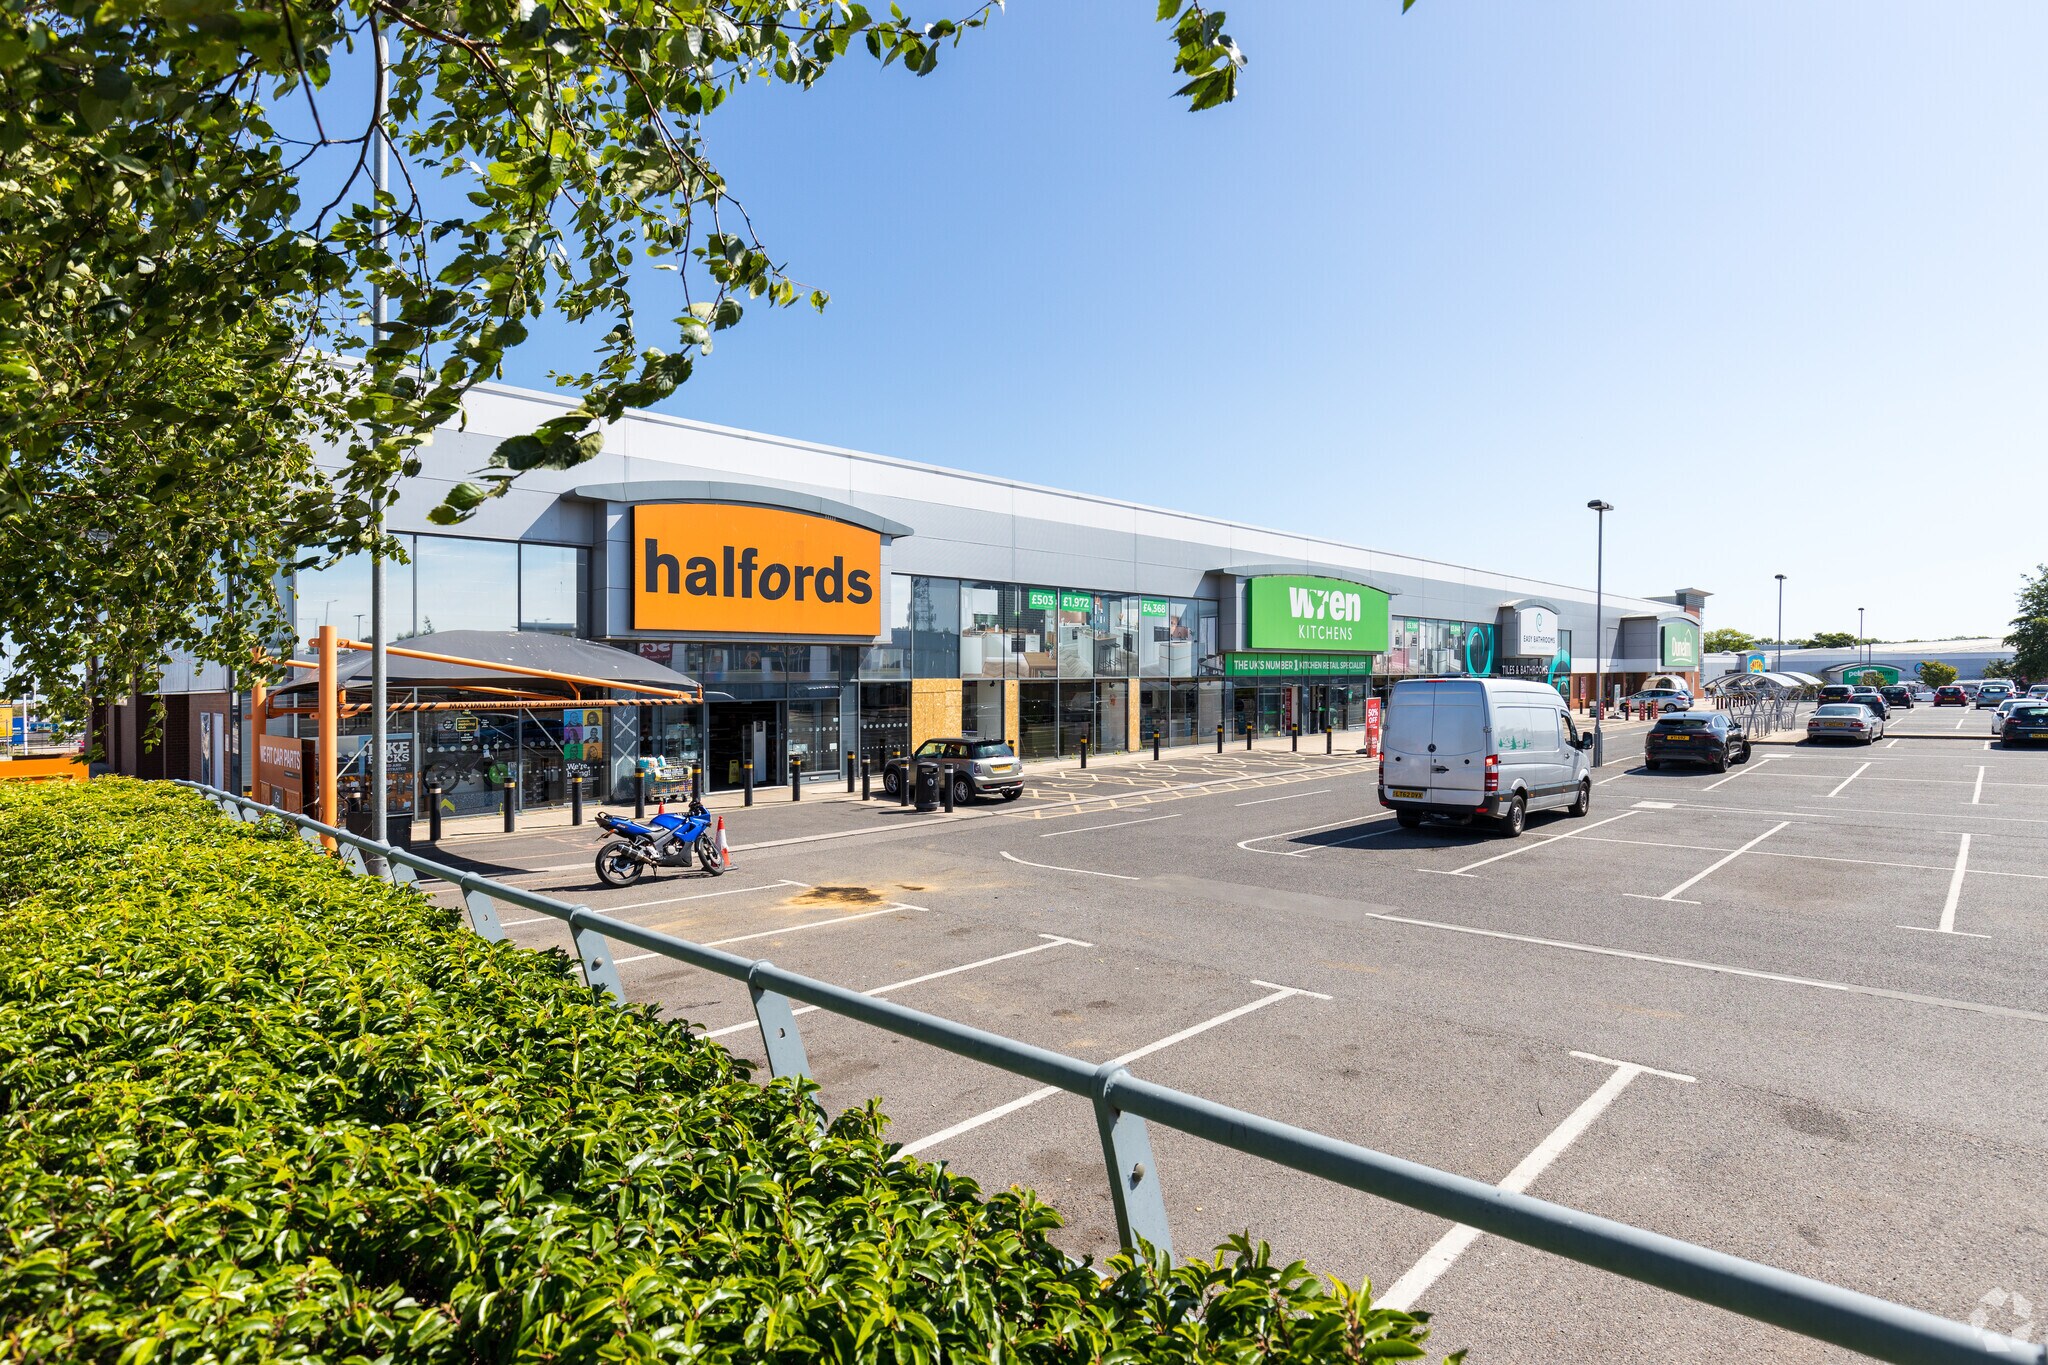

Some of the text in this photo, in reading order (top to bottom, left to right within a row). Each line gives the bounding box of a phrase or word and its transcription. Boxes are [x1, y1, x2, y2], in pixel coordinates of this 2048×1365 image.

[645, 537, 873, 605] halfords
[1031, 594, 1054, 606] £503
[1063, 596, 1090, 608] £1,972
[1289, 586, 1361, 622] wren
[1298, 624, 1353, 641] KITCHENS
[1523, 634, 1556, 644] EASY BATHROOMS
[1671, 635, 1692, 657] Dunelm
[1233, 660, 1249, 670] THE
[1265, 660, 1293, 670] NUMBER
[1294, 659, 1299, 671] 1
[1299, 661, 1322, 670] KITCHEN
[1322, 661, 1339, 670] RETAIL
[1340, 661, 1366, 670] SPECIALIST
[1502, 665, 1515, 675] TILES
[1520, 665, 1548, 675] BATHROOMS
[1368, 708, 1379, 717] 50%
[1368, 716, 1378, 724] OFF
[273, 748, 284, 767] CAR
[284, 749, 301, 770] PARTS
[567, 763, 589, 771] We're
